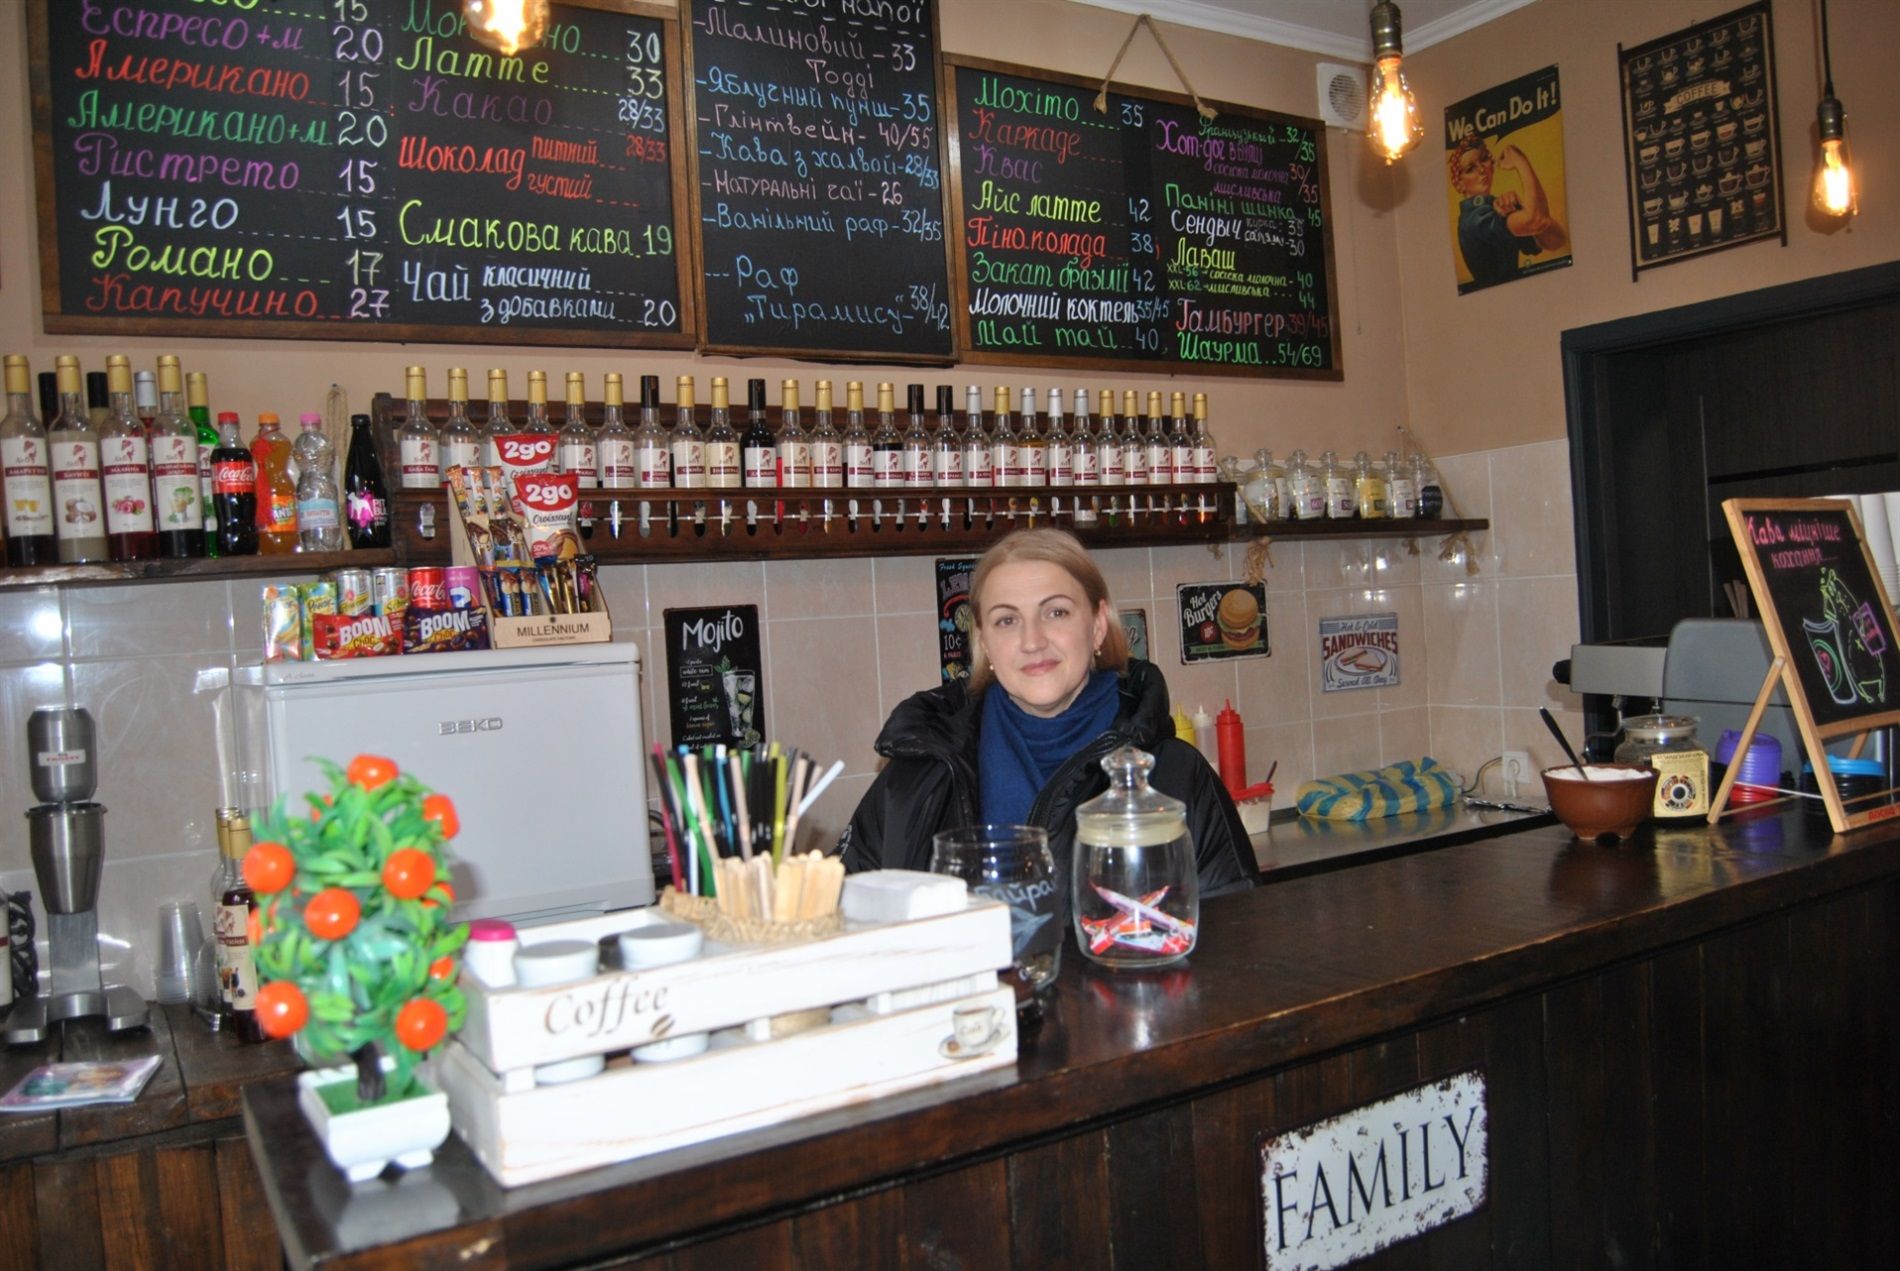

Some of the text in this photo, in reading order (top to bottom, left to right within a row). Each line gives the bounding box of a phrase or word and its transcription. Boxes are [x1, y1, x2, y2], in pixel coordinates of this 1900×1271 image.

[333, 26, 384, 61] 20
[626, 30, 661, 64] 30
[892, 43, 916, 72] 33
[75, 38, 380, 107] Американо 15
[396, 36, 663, 99] Латте 33
[806, 59, 874, 98] Тодді
[408, 75, 665, 133] Какао 28/33
[902, 93, 930, 121] 35
[974, 77, 1143, 127] Мохіто 35
[1448, 81, 1557, 143] We Can Do It!
[1676, 82, 1718, 105] COFFEE
[338, 111, 388, 148] 20
[879, 122, 933, 151] 40/55
[968, 107, 1081, 165] Каркаде
[1156, 119, 1226, 172] Хот-дог
[74, 132, 378, 194] Ристрето 15
[399, 135, 666, 191] Шоколад питний 28/33
[795, 150, 807, 177] з
[974, 144, 1044, 184] Квас
[527, 173, 593, 200] густий
[881, 181, 903, 205] 26
[972, 180, 1152, 223] Айс латте 42
[80, 180, 377, 239] Лунго 15
[1165, 183, 1235, 215] Паніні
[1308, 207, 1322, 228] 45
[400, 200, 672, 257] Смакова кава 19
[845, 217, 889, 241] раф
[901, 208, 942, 241] 32/35
[1131, 232, 1154, 253] 38
[91, 225, 385, 286] Романо 17
[971, 251, 1054, 287] Закат
[1133, 268, 1155, 292] 42
[1171, 237, 1236, 271] Лаваш
[403, 260, 591, 301] Чай класичний
[735, 254, 799, 296] Раф
[1297, 271, 1313, 290] 40
[84, 272, 390, 319] Капучино 27
[644, 300, 676, 327] 20
[969, 287, 1061, 320] Молочний
[1067, 297, 1140, 324] коктель
[976, 320, 1159, 351] Май тай 40
[1176, 298, 1285, 338] Гамбургер
[1177, 331, 1262, 365] Шаурма
[504, 440, 551, 460] 2go
[525, 483, 573, 506] 2go
[532, 512, 573, 526] Croissant
[1183, 590, 1222, 628] Burgers
[1190, 593, 1207, 610] Hot
[339, 615, 393, 646] BOOM
[420, 610, 471, 641] BOOM
[516, 623, 590, 637] MILLENNIUM
[682, 609, 744, 653] Mojito
[1322, 631, 1398, 660] SANDWICHES
[438, 716, 503, 735] BEKO
[543, 974, 669, 1038] Coffee
[1271, 1104, 1480, 1251] FAMILY
